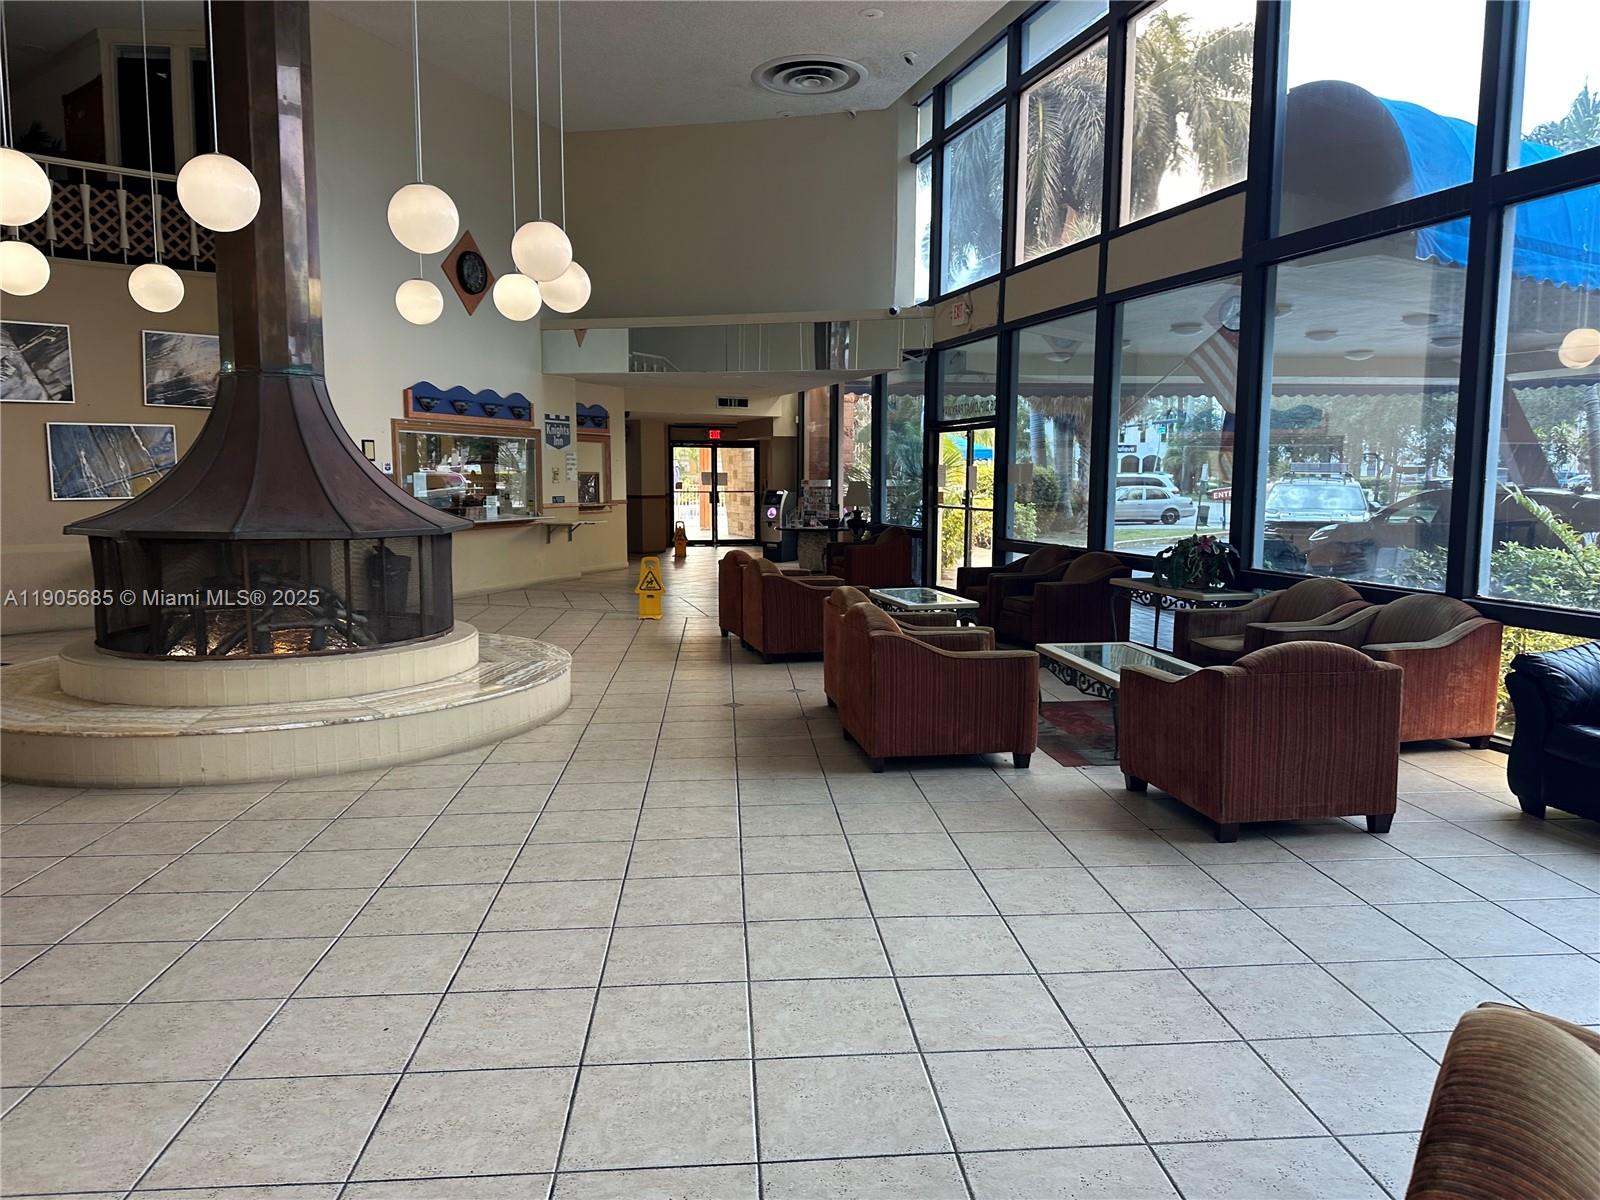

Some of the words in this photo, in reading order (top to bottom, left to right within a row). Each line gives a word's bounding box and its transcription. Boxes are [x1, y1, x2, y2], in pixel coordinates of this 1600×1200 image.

[954, 303, 964, 320] EXIT
[547, 424, 569, 437] Knights
[709, 430, 720, 439] EXIT
[554, 436, 563, 446] Inn
[1213, 490, 1232, 499] ENTE
